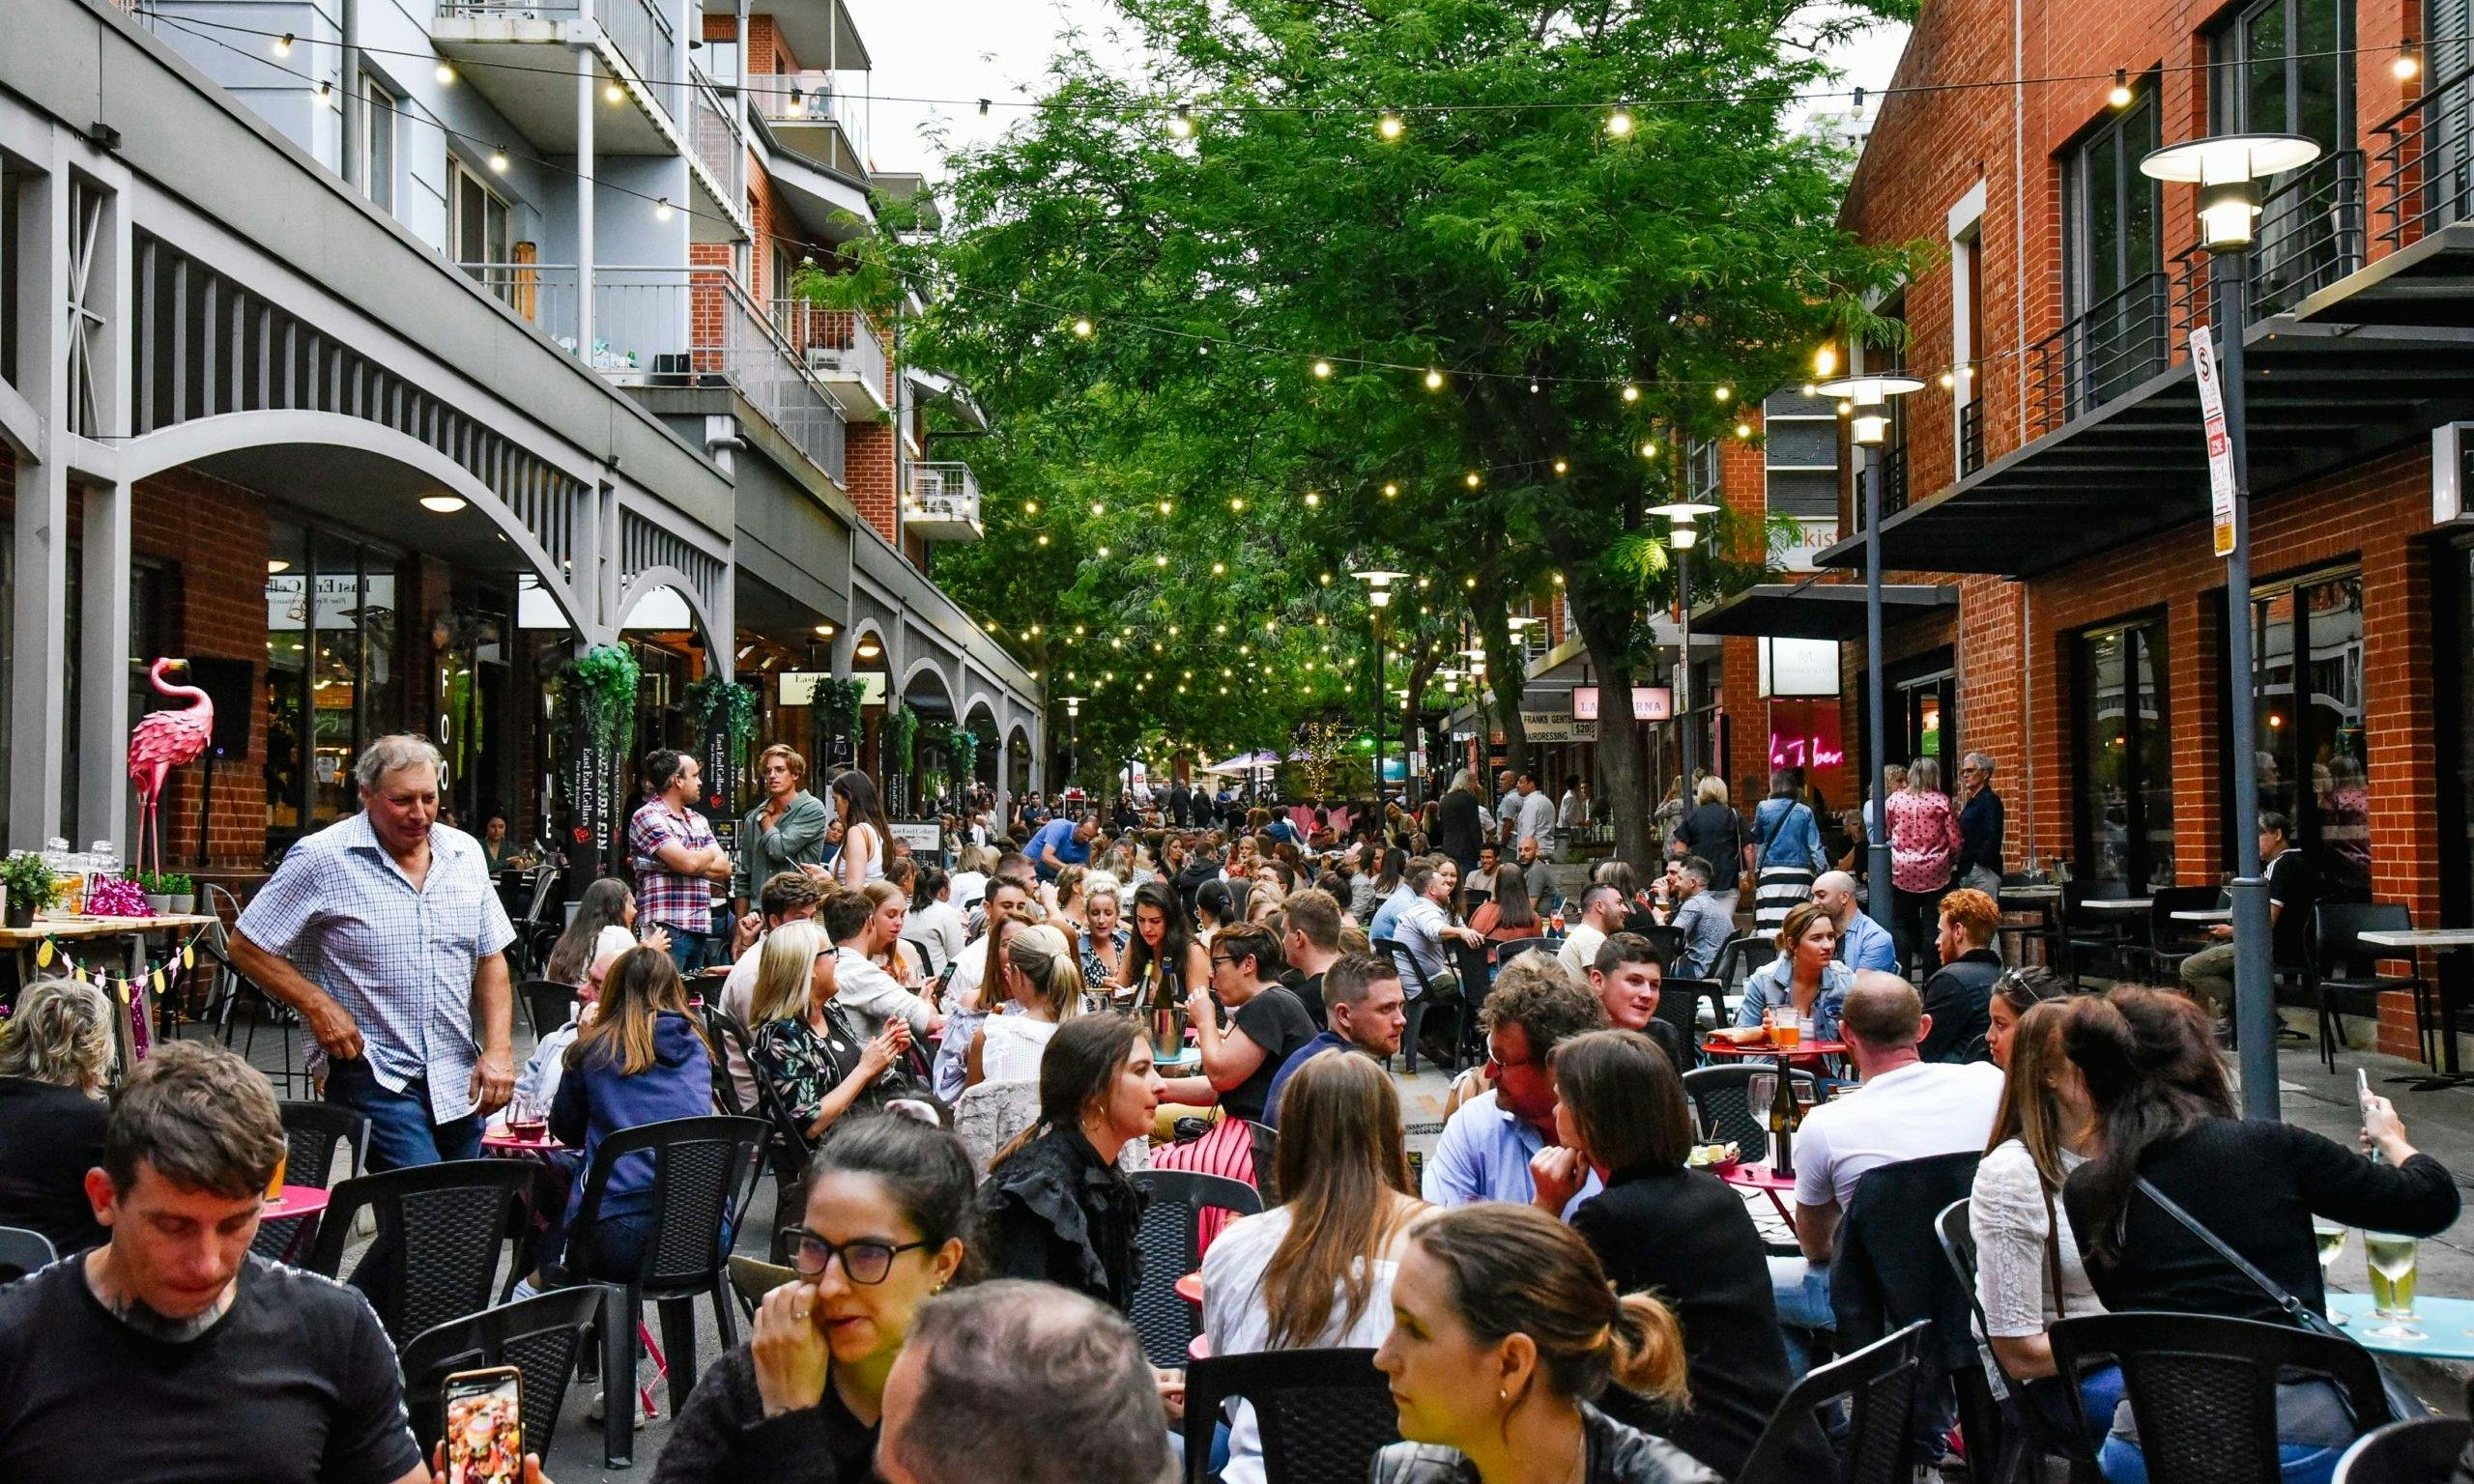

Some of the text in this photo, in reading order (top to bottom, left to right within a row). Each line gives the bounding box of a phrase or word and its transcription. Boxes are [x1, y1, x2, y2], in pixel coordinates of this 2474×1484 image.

[1524, 714, 1573, 725] FRANKS GENTS
[1634, 701, 1662, 712] RNA
[441, 668, 449, 791] FOO
[1575, 725, 1590, 734] $20
[716, 733, 725, 795] East End Cellars
[582, 748, 593, 827] East End Cellars
